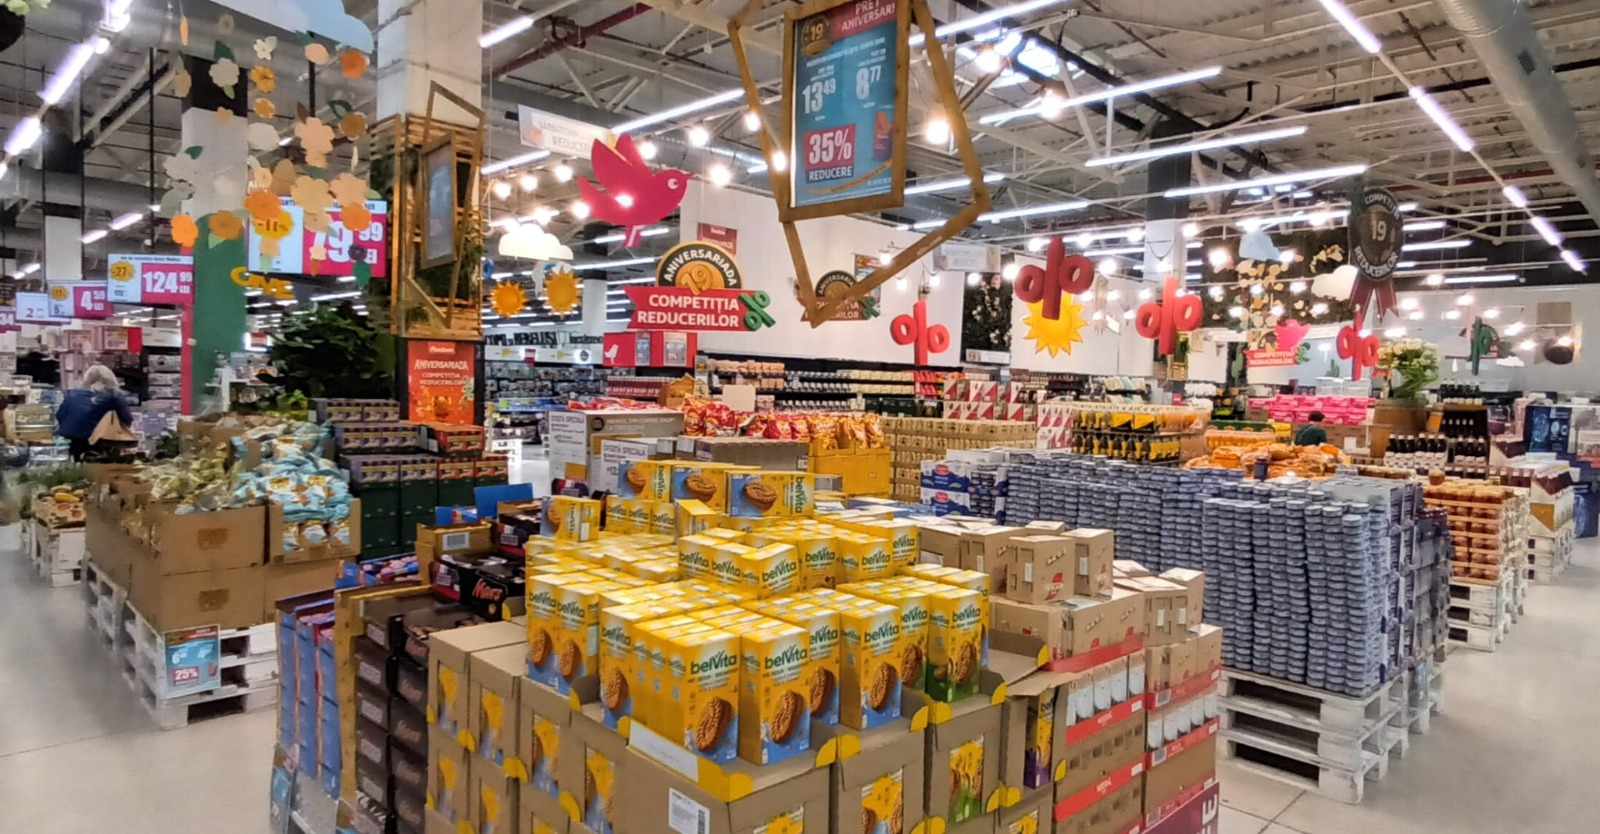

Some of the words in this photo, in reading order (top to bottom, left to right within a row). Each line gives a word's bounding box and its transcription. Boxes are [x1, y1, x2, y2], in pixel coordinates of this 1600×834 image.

[841, 3, 896, 32] ANIVERSAR!
[810, 23, 824, 41] 19
[856, 67, 869, 100] 8
[802, 81, 823, 114] 13
[823, 78, 837, 95] 49
[808, 128, 853, 165] 35%
[808, 166, 853, 181] REDUCERE
[1370, 220, 1387, 241] 19
[663, 248, 737, 287] ANIVERSARIADA
[143, 271, 178, 293] 124
[179, 272, 193, 282] 99
[681, 264, 712, 296] 19
[81, 291, 93, 310] 4
[637, 311, 739, 328] REDUCERILOR
[414, 360, 469, 370] ANIVERSARIADA
[657, 466, 666, 499] belVita
[795, 476, 808, 514] belVita
[679, 551, 709, 569] belVita
[804, 547, 836, 563] belVita
[861, 549, 891, 566] belVita
[711, 558, 741, 578] belVita
[762, 559, 797, 582] belVita
[472, 578, 503, 601] Mars
[529, 590, 556, 609] belVita
[557, 600, 586, 618] belVita
[952, 603, 981, 622] belVita
[602, 625, 631, 647] belVita
[864, 621, 900, 643] belVita
[690, 650, 737, 675] belVita
[764, 644, 808, 670] belVita
[174, 668, 198, 681] 25%
